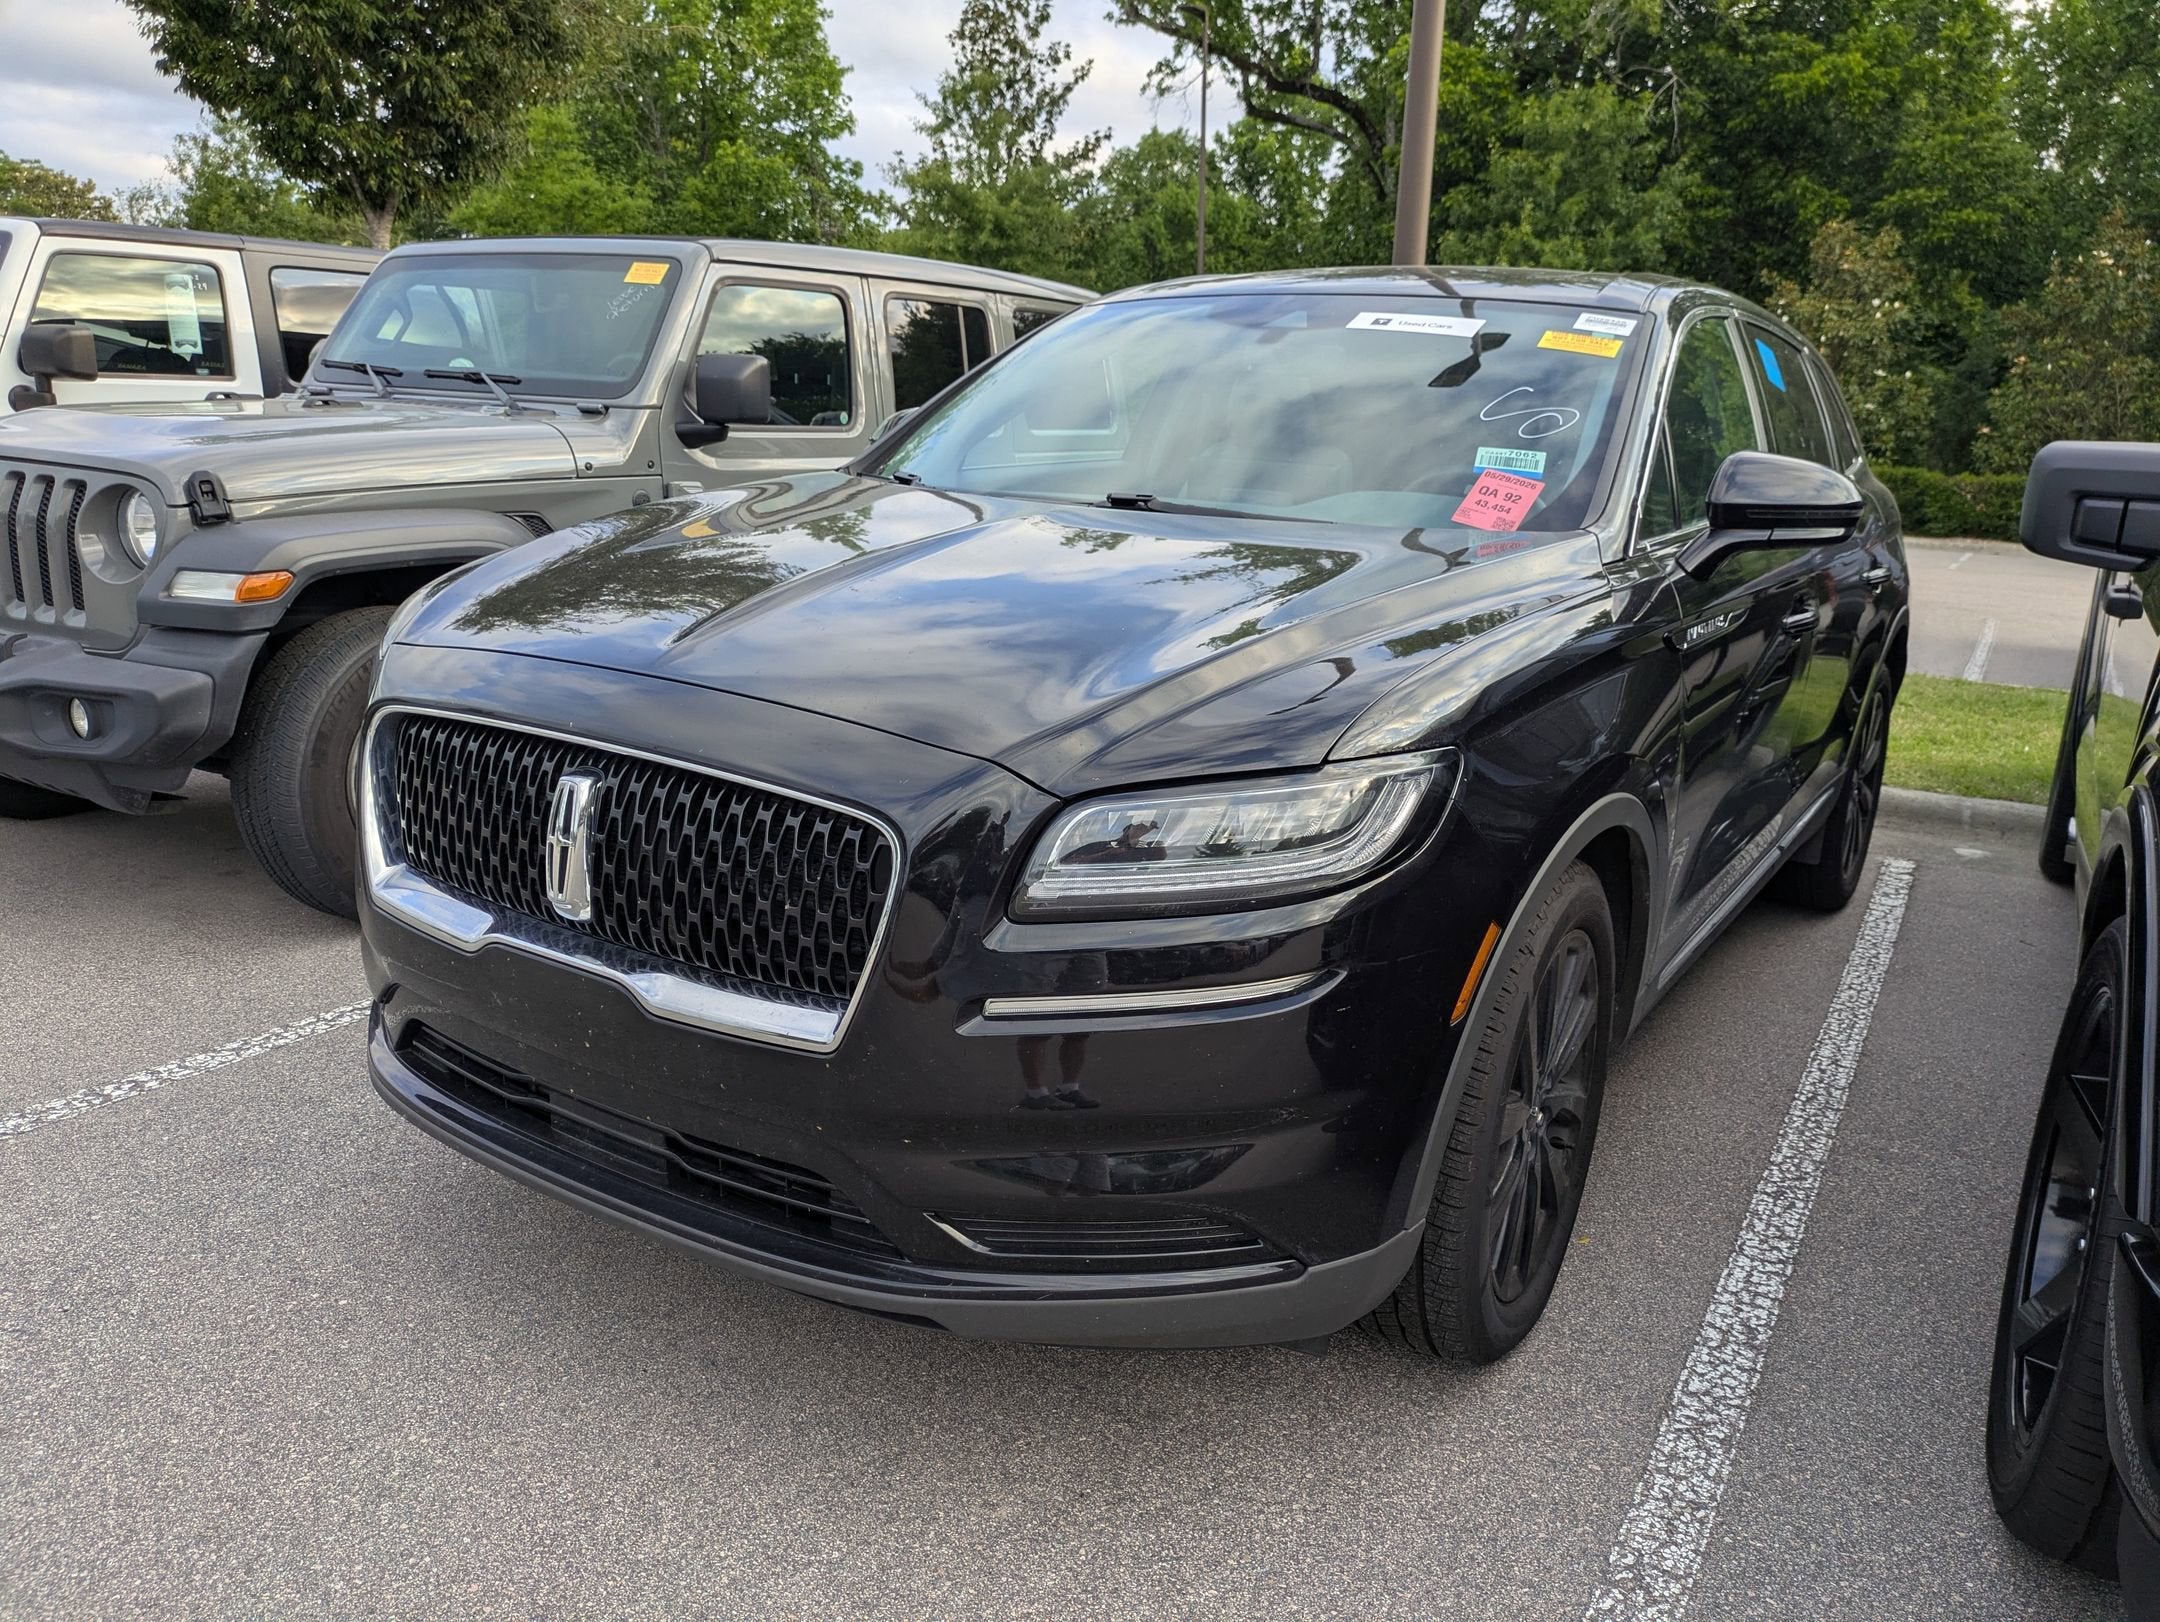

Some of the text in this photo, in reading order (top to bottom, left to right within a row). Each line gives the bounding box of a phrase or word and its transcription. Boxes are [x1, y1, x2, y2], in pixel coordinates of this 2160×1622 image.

[1398, 320, 1454, 330] Used Cars
[1484, 470, 1538, 490] 05/29/2026
[1478, 485, 1499, 499] QA
[1503, 492, 1523, 505] 92
